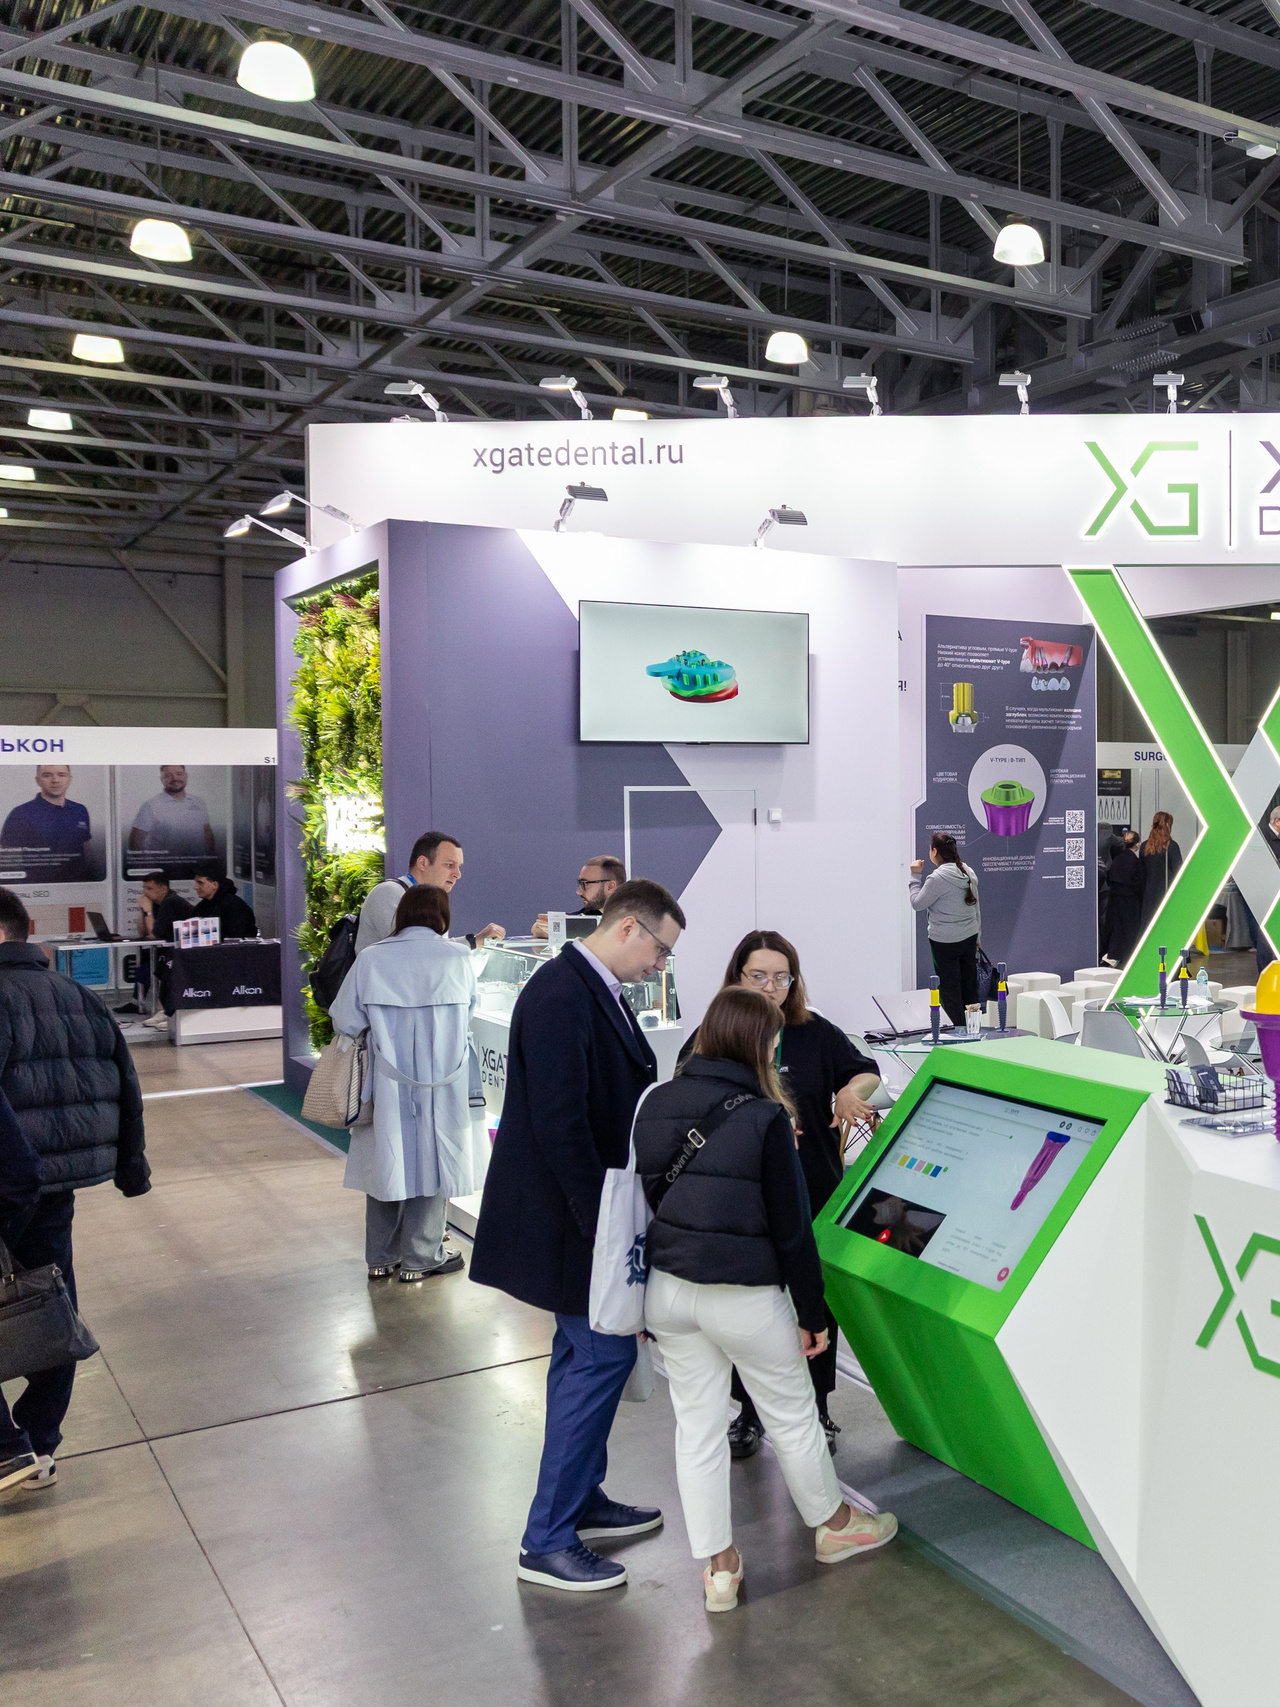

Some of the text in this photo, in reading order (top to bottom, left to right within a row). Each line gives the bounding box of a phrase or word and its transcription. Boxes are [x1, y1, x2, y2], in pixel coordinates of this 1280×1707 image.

[472, 437, 684, 474] xgatedental.ru
[1083, 440, 1199, 537] XG
[232, 985, 262, 996] Alkon
[482, 1046, 508, 1075] XGAT
[482, 1071, 505, 1091] DENT
[665, 1154, 689, 1183] Calvin
